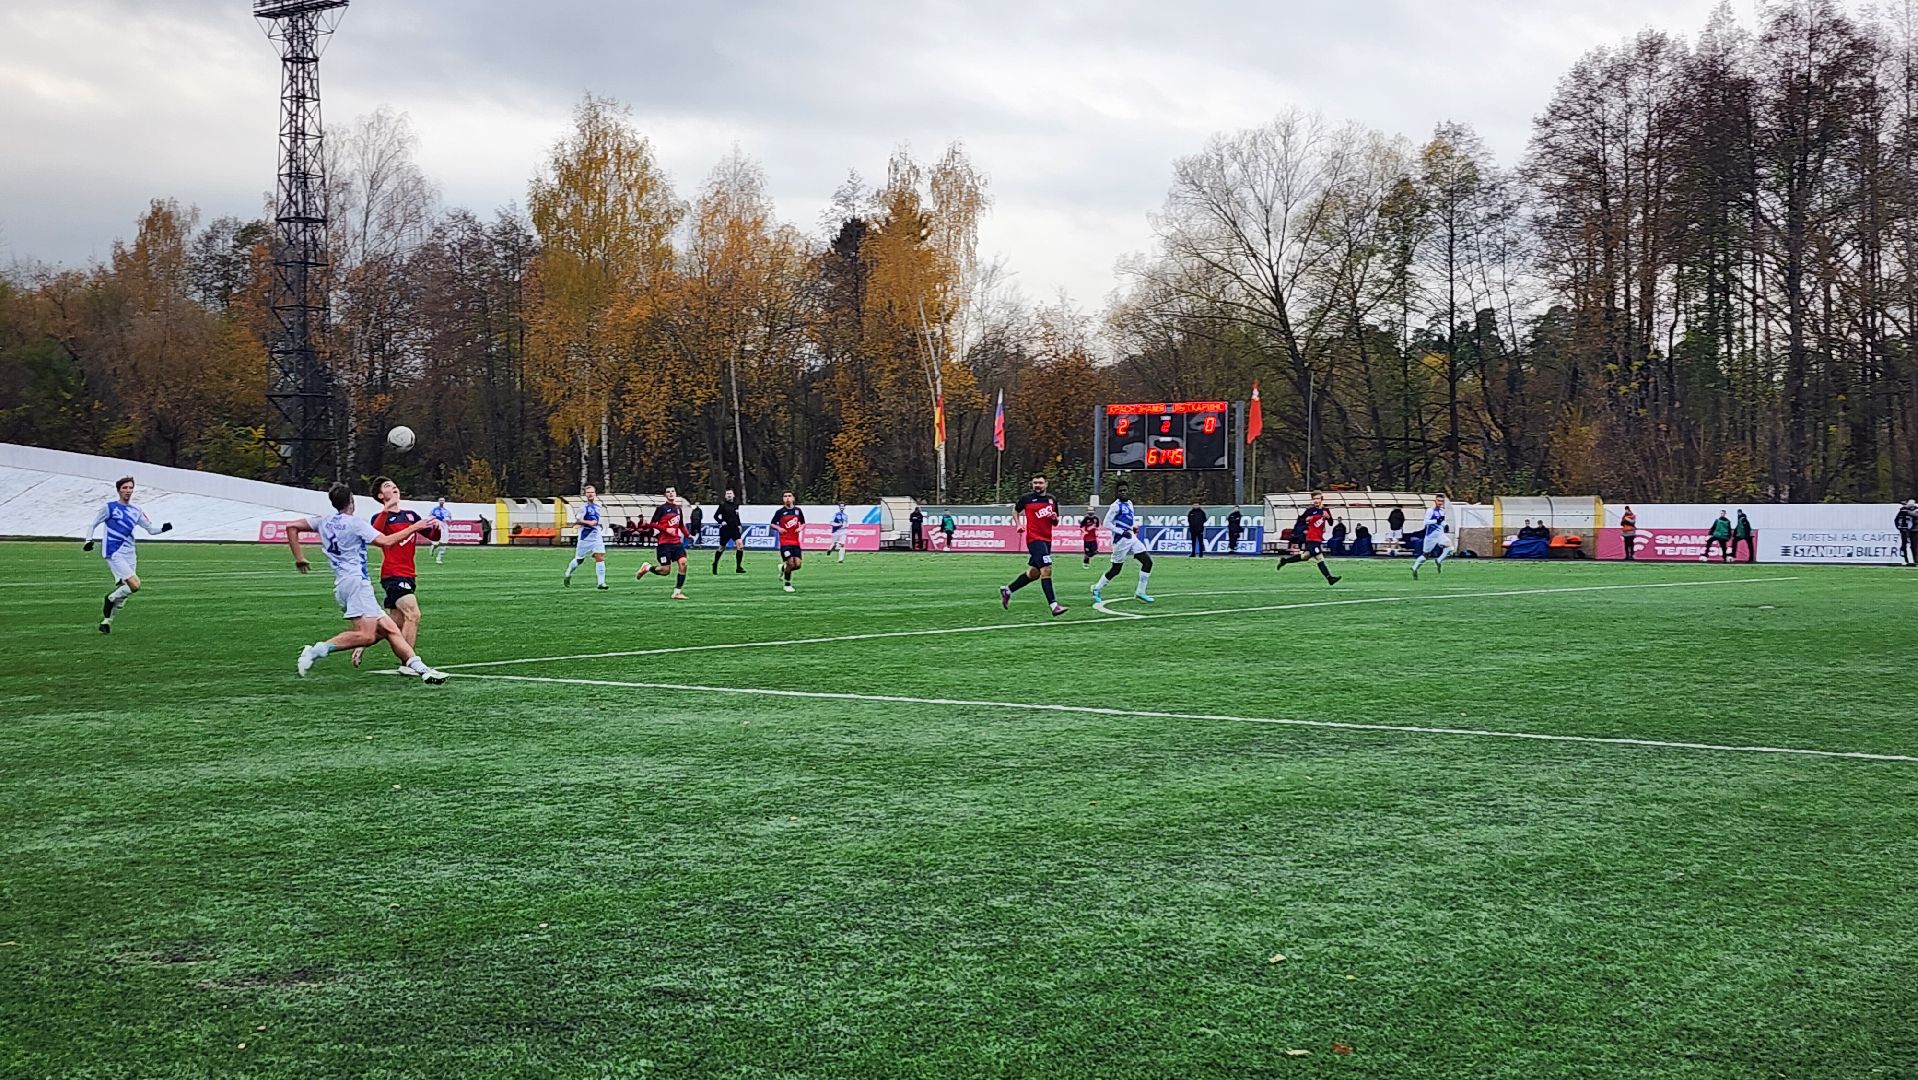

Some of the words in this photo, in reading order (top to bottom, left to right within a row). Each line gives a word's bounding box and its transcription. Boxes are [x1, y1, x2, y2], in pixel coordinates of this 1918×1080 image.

[1117, 418, 1129, 435] 2
[1161, 421, 1171, 433] 2
[1203, 416, 1216, 433] 0
[327, 533, 342, 555] 4
[1791, 533, 1837, 542] БИЛЕТЫ
[1842, 533, 1857, 542] НА
[1795, 545, 1853, 557] STANDUP
